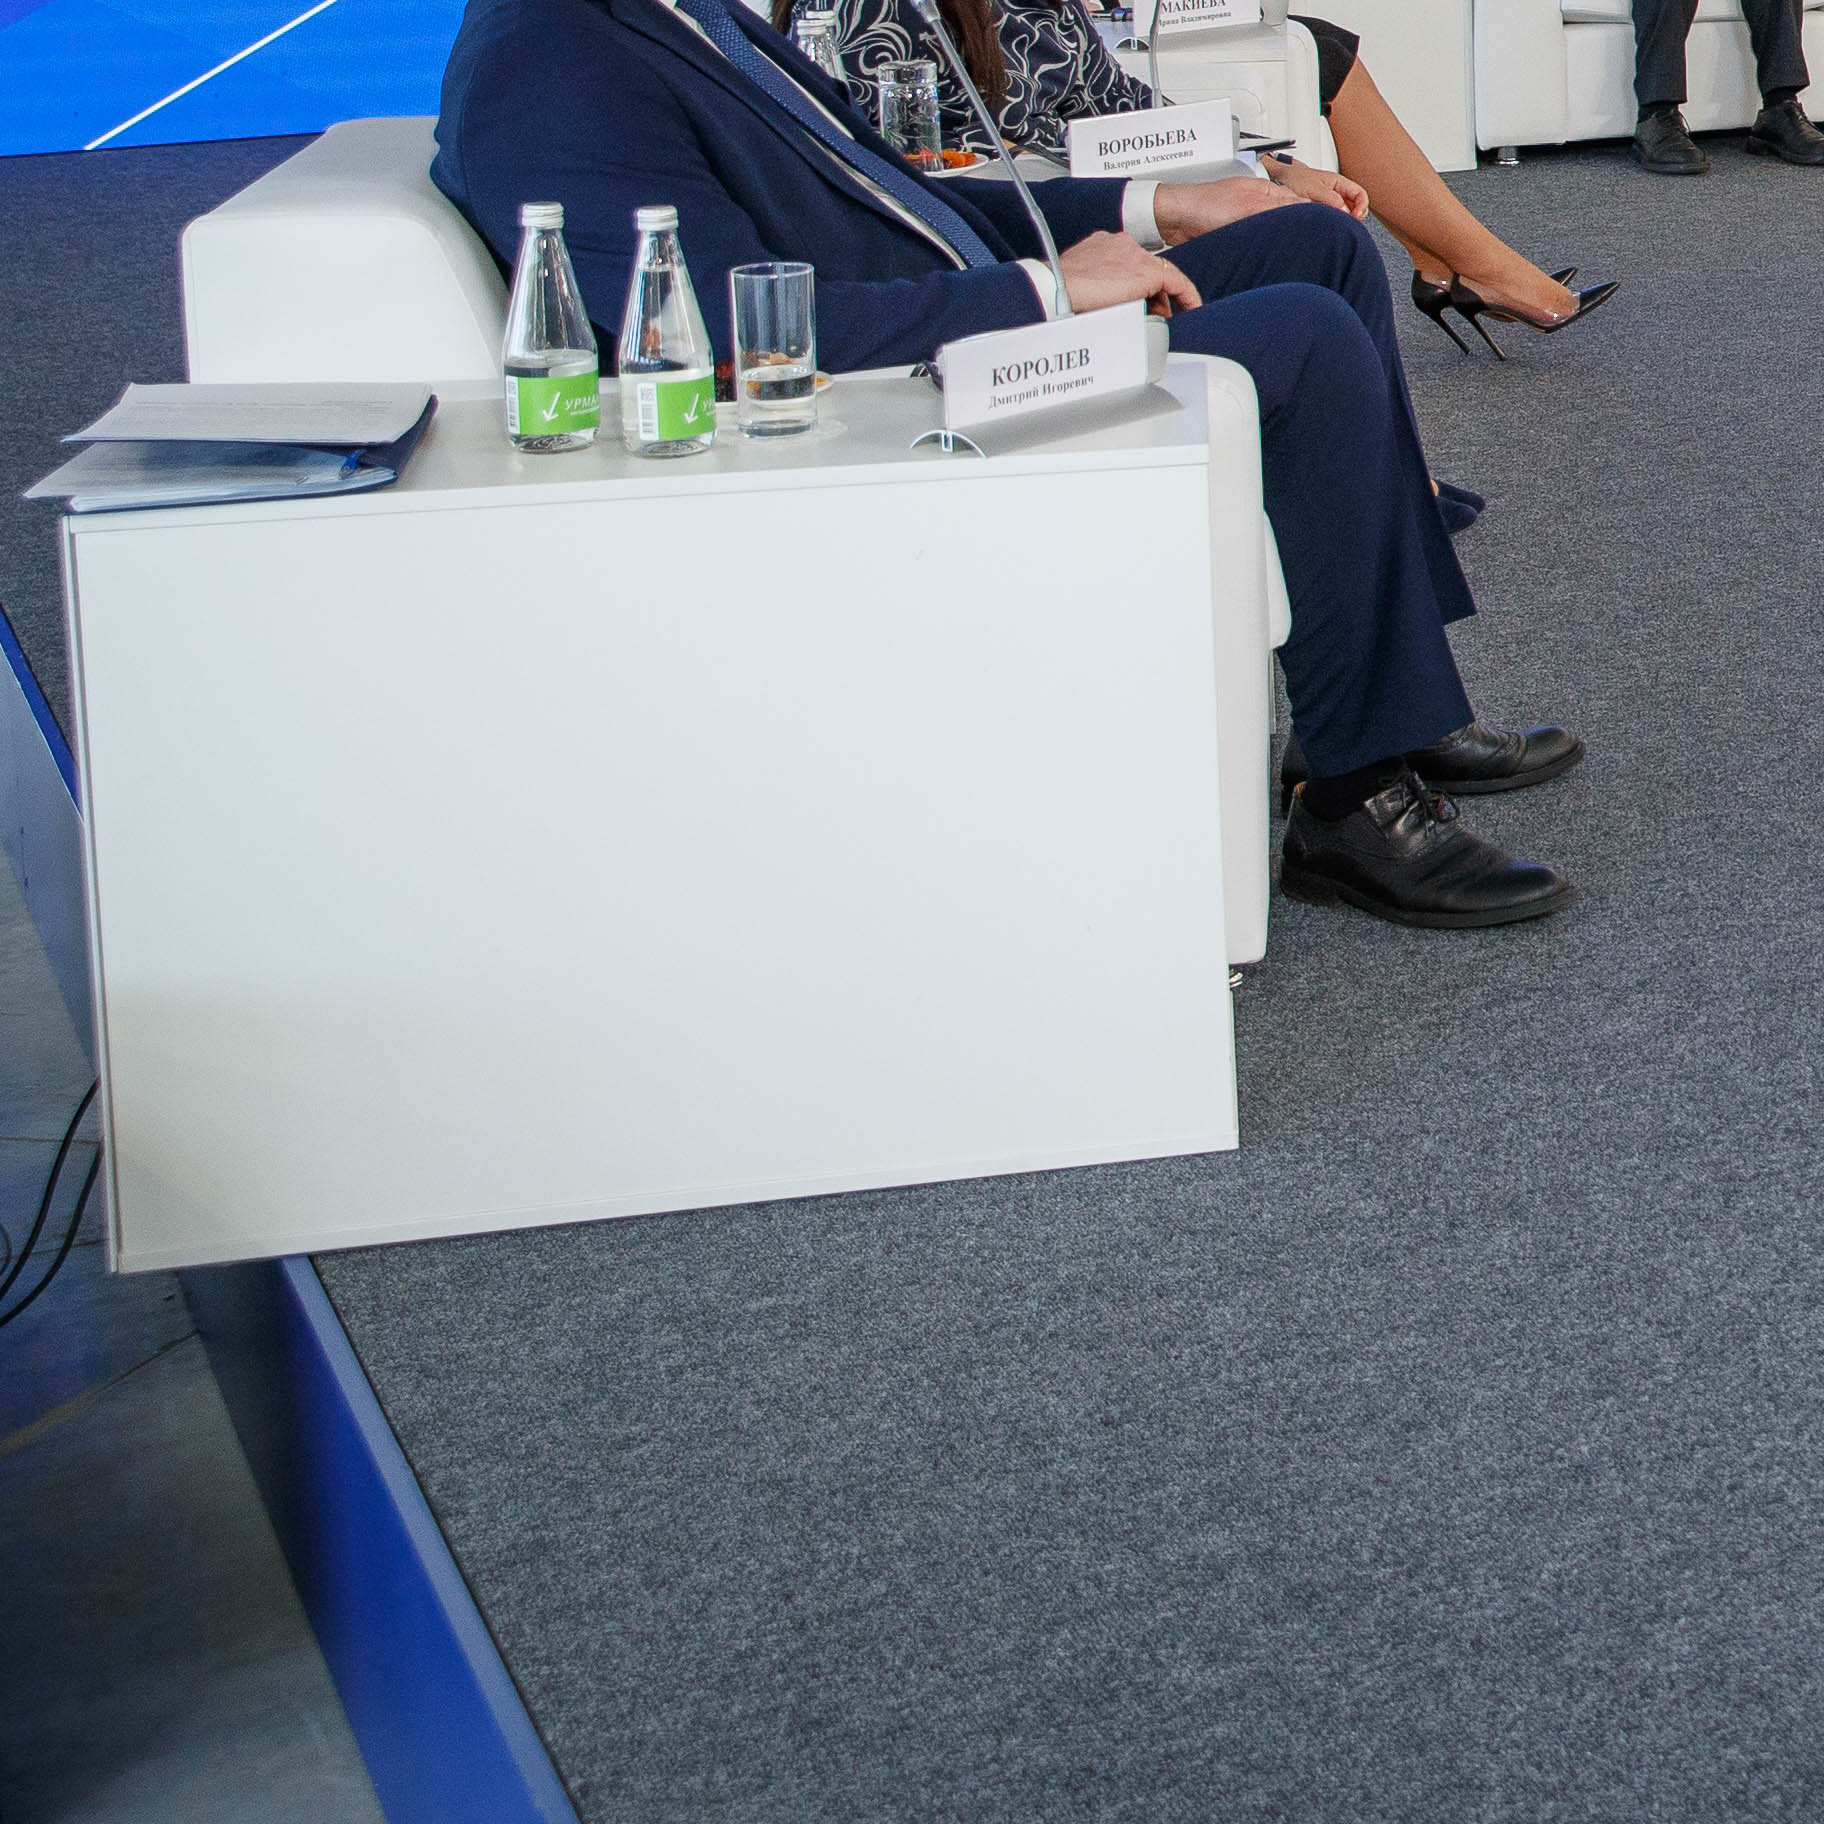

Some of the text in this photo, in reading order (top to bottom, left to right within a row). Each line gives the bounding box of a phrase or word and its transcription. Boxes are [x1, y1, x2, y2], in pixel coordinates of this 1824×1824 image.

[1098, 127, 1198, 157] ВОРОБЬЕВА
[1103, 148, 1194, 172] Валерия Алексеевна
[992, 348, 1090, 388] КОРОЛЕВ
[988, 375, 1094, 410] Дмитрий Игоревич
